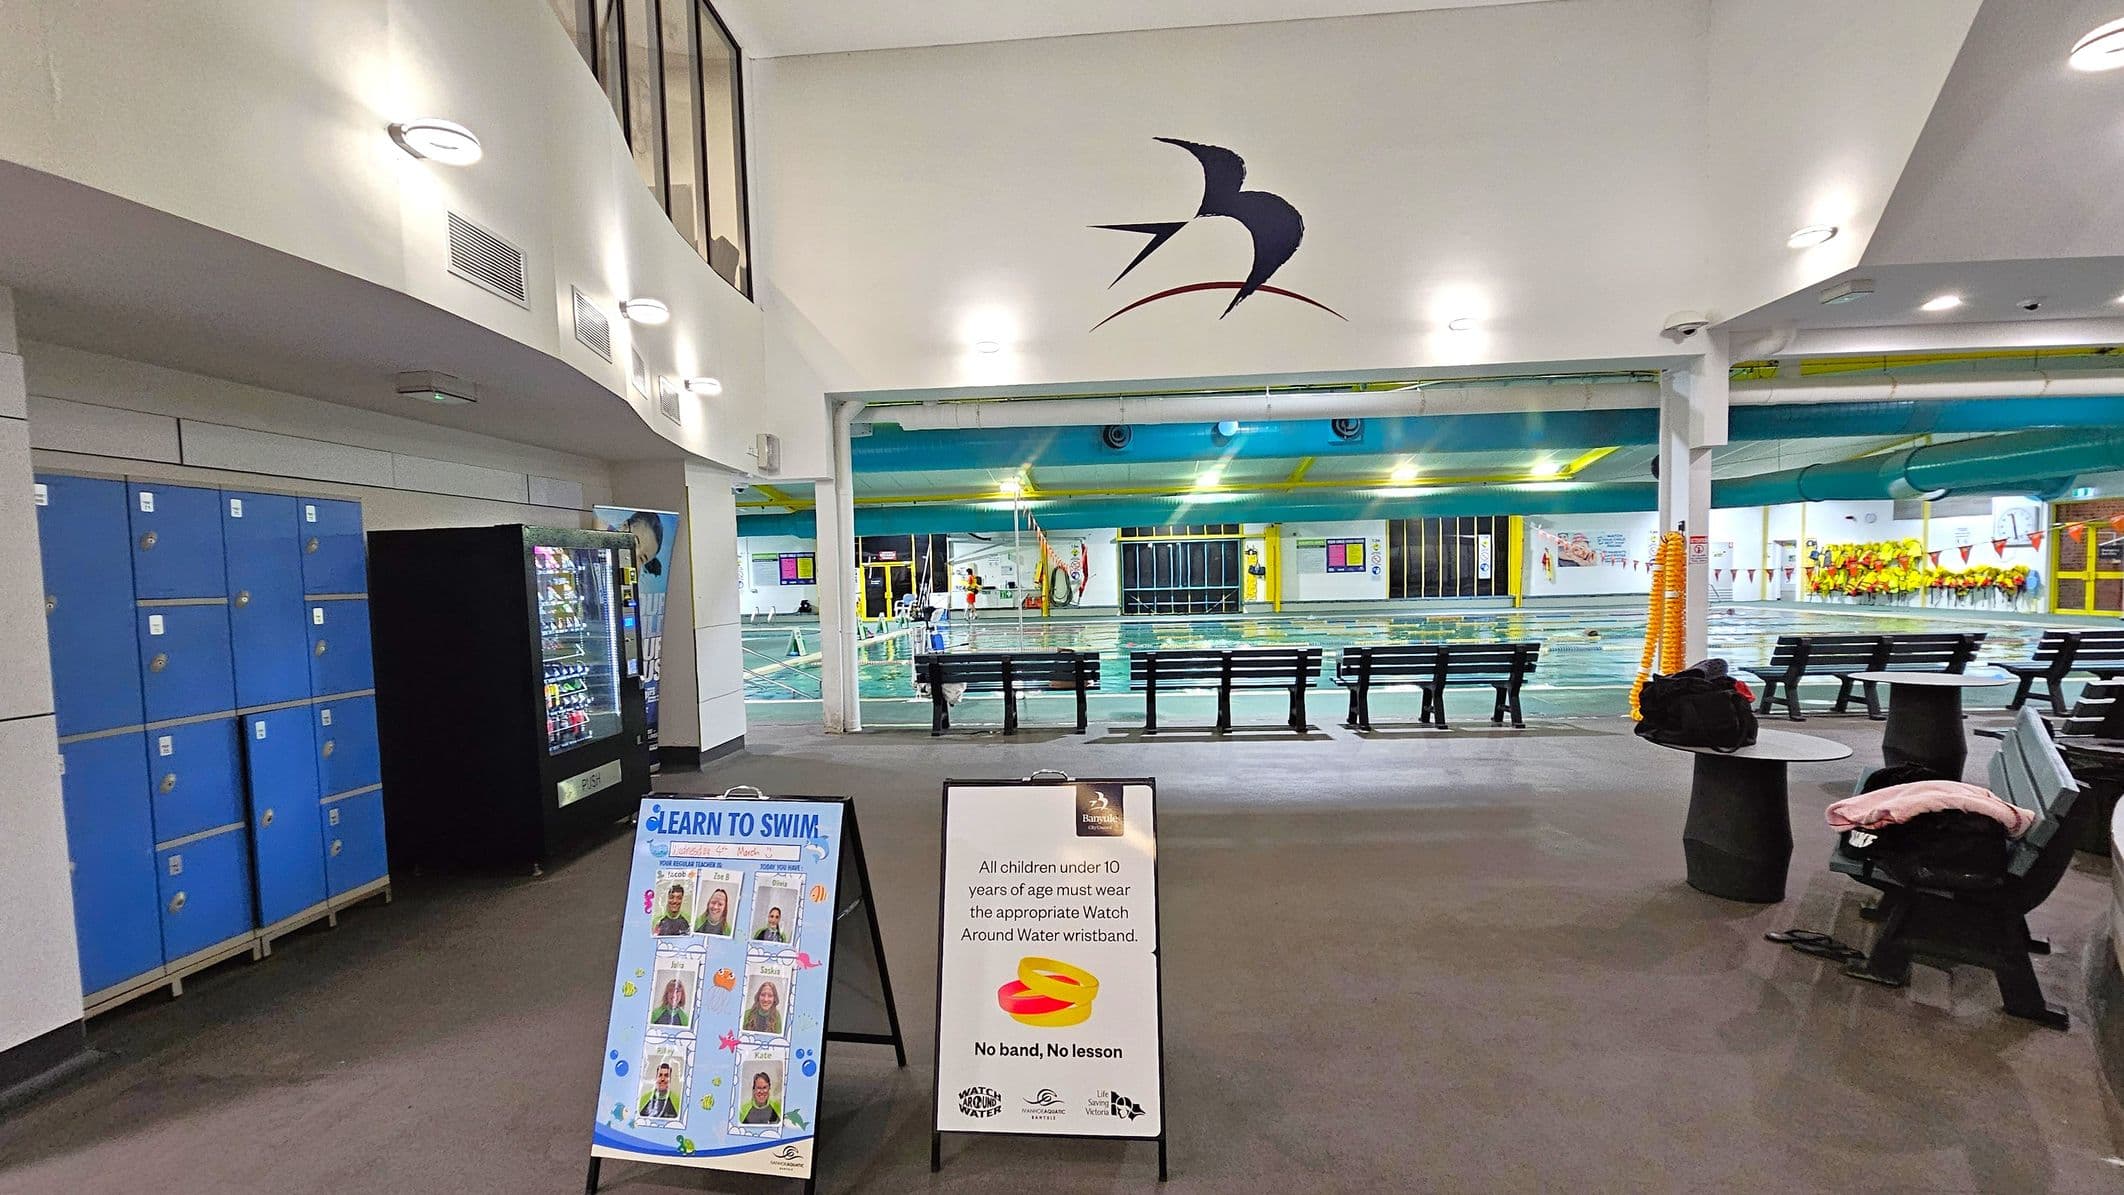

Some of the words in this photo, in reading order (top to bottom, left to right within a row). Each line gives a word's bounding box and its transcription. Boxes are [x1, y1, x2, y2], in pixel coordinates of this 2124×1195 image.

[581, 772, 601, 790] PUSH
[657, 810, 722, 836] LEARN
[728, 812, 754, 837] TO
[760, 813, 819, 839] SWIM
[1082, 813, 1119, 824] Banyule
[737, 846, 760, 857] March
[672, 860, 695, 868] REGULAR
[978, 860, 997, 874] All
[1000, 860, 1057, 874] children
[1060, 860, 1101, 874] under
[1105, 860, 1120, 874] 10
[713, 871, 725, 880] Zoe
[968, 885, 1007, 899] years
[1010, 883, 1026, 896] of
[1027, 885, 1053, 899] age
[1056, 884, 1092, 896] must
[1095, 886, 1131, 896] wear
[970, 905, 993, 919] the
[996, 905, 1080, 921] appropriate
[1083, 905, 1129, 919] Watch
[960, 928, 1014, 942] Around
[1017, 928, 1060, 942] Water
[1062, 928, 1139, 942] wristband.
[759, 965, 781, 975] Saskia
[754, 1051, 772, 1060] Kate
[975, 1042, 996, 1056] No
[999, 1042, 1043, 1059] band,
[1047, 1043, 1069, 1057] No
[1072, 1043, 1123, 1058] lesson
[958, 1086, 1001, 1102] WATCH
[1096, 1090, 1109, 1098] Life
[963, 1095, 997, 1109] AROUND
[1087, 1099, 1109, 1109] Saving
[958, 1103, 1001, 1119] WATER
[1085, 1108, 1110, 1116] Victoria
